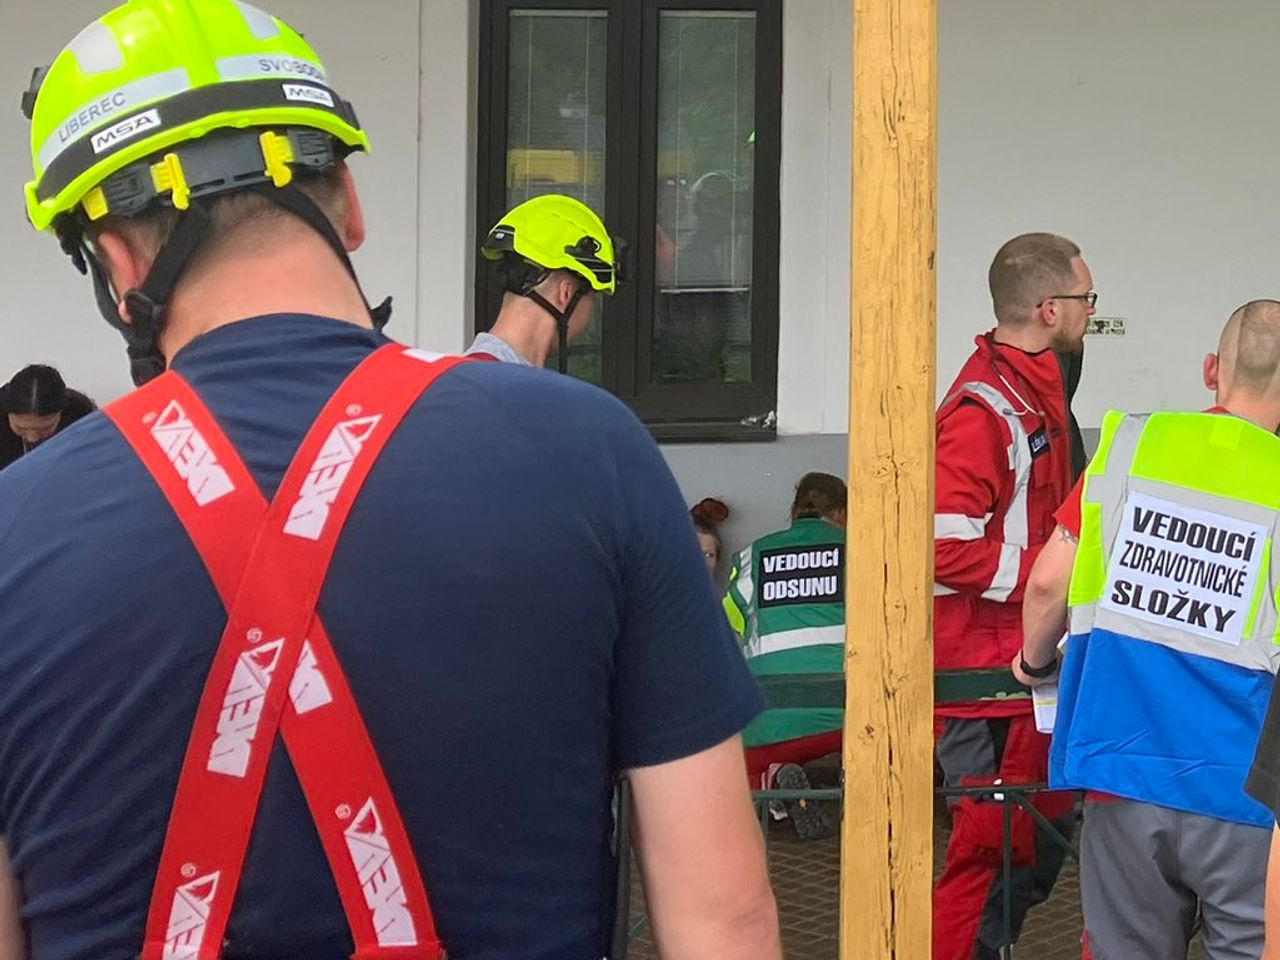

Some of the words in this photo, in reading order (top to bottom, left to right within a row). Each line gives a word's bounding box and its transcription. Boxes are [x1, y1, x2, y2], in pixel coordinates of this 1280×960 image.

[59, 92, 126, 142] LIBEREC
[97, 116, 153, 148] MSA
[1132, 506, 1257, 562] VEDOUCÍ
[762, 548, 840, 574] VEDOUCÍ
[1119, 540, 1247, 597] ZDRAVOTNICKÉ
[762, 576, 837, 601] ODSUNU
[1111, 579, 1236, 633] SLOŽKY
